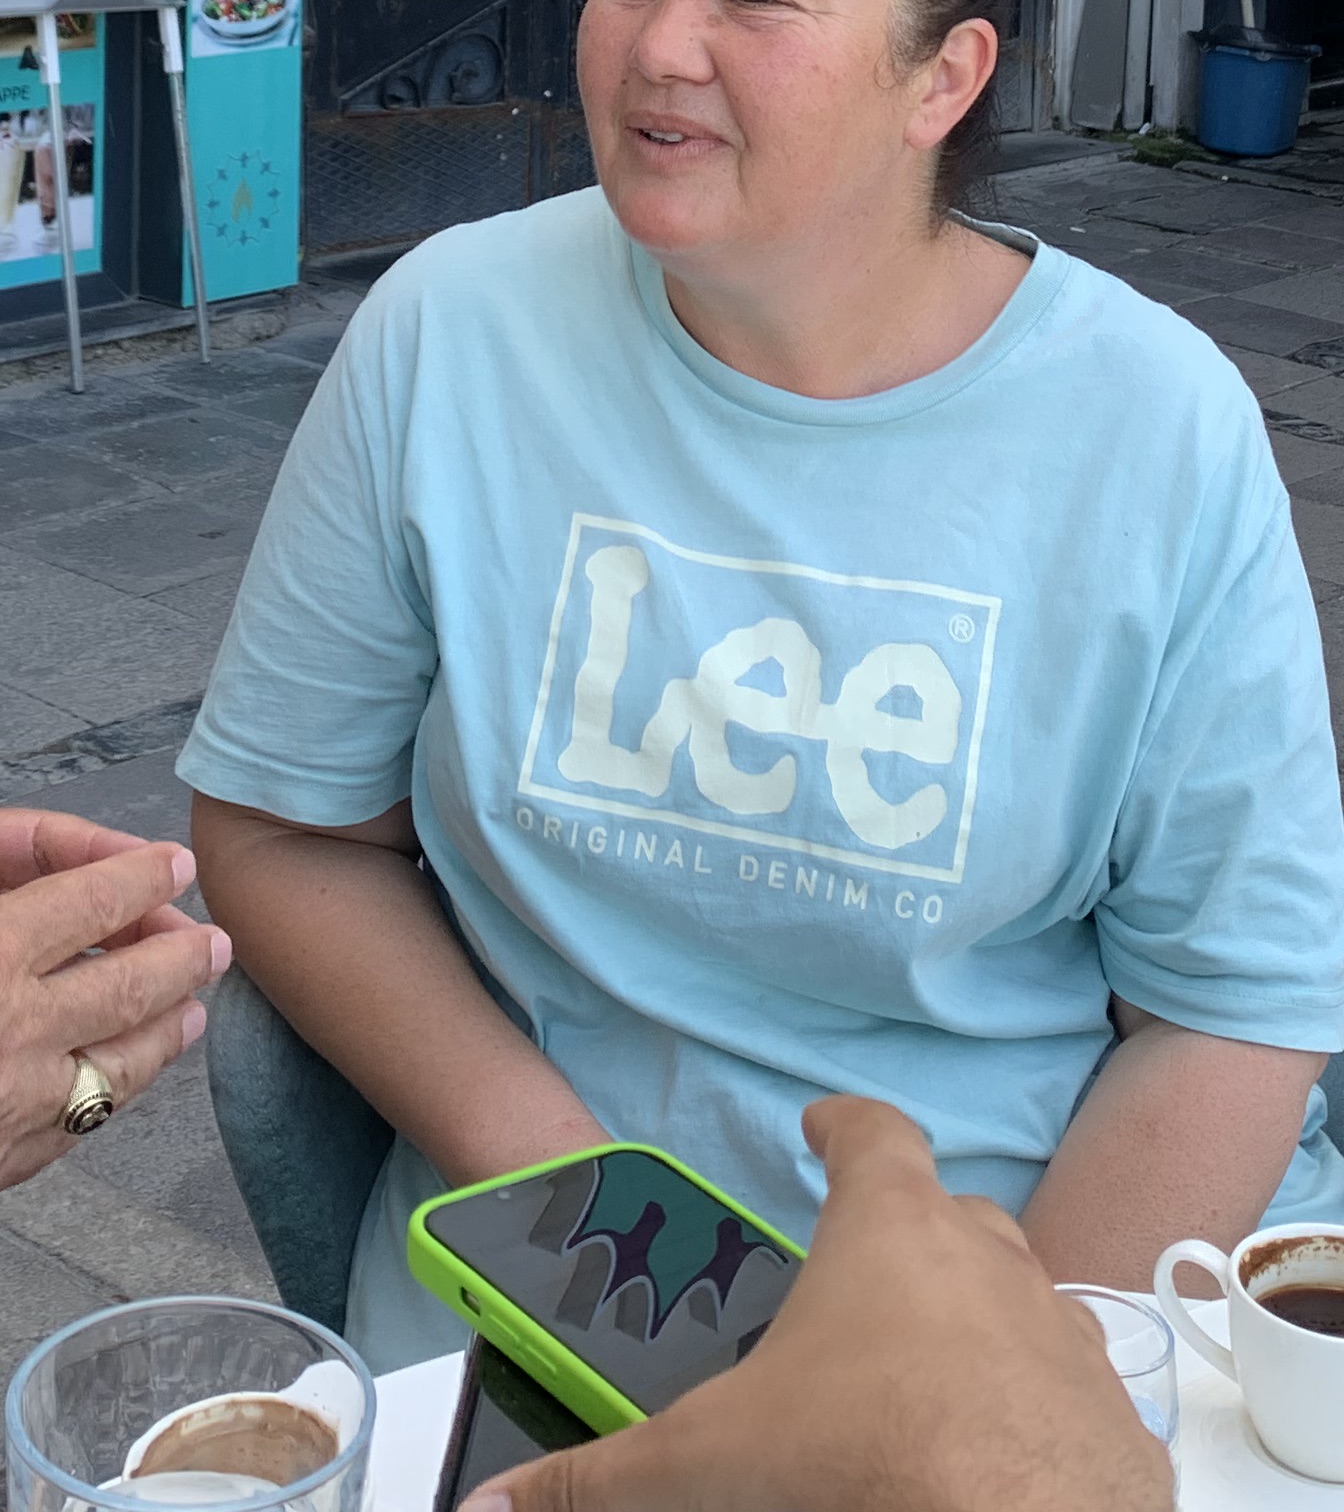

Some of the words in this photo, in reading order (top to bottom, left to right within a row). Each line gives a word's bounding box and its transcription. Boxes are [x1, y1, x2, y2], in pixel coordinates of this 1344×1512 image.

[558, 545, 962, 850] Lee
[516, 806, 713, 875] ORIGINAL
[738, 855, 870, 912] DENIM
[894, 889, 945, 924] CO
